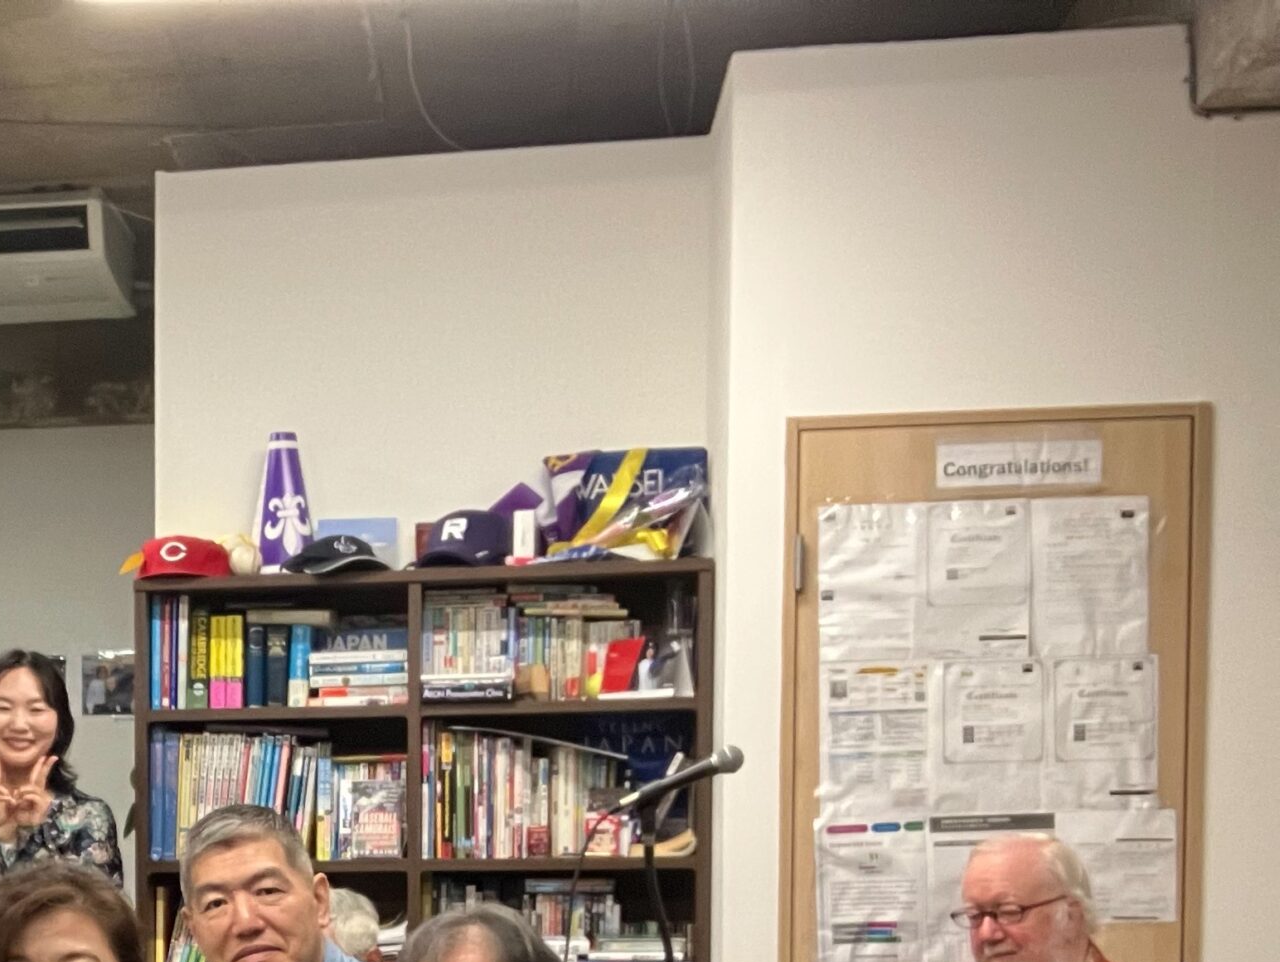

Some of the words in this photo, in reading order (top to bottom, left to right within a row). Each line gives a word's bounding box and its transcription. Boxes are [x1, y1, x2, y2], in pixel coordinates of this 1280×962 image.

[943, 458, 1090, 479] Congratulations!
[440, 517, 468, 542] R
[159, 541, 187, 562] C
[325, 632, 389, 651] JAPAN
